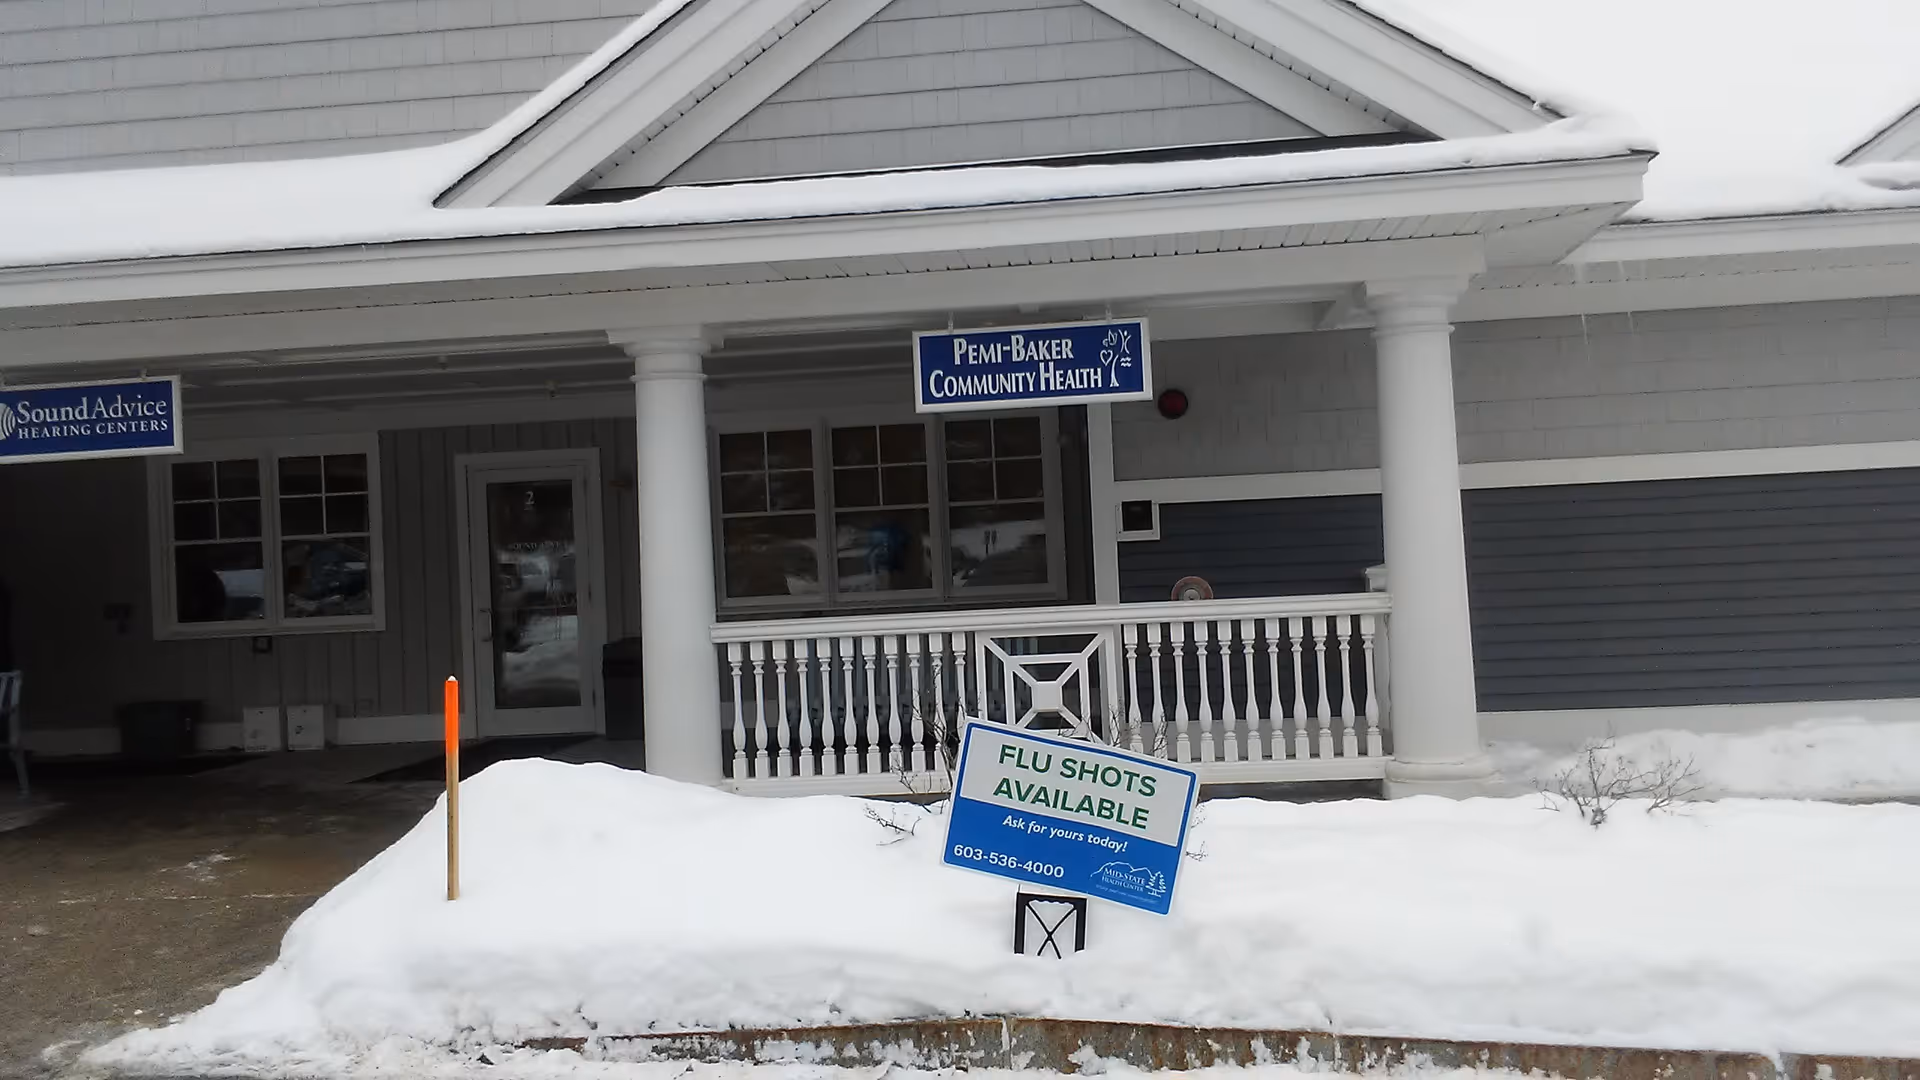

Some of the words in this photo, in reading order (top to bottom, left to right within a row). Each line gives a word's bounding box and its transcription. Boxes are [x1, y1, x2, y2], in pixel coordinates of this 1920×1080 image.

[18, 424, 91, 440] HEARING
[96, 419, 169, 435] CENTERS
[525, 490, 535, 505] 2
[998, 743, 1052, 774] FLU
[1059, 757, 1157, 798] SHOTS
[993, 777, 1150, 830] AVAILABLE
[1002, 814, 1025, 830] Ask
[1027, 820, 1047, 836] for
[1049, 827, 1085, 844] yours
[1087, 833, 1128, 854] today!
[953, 844, 1065, 879] 603-536-4000
[1103, 867, 1146, 885] MID-STATE
